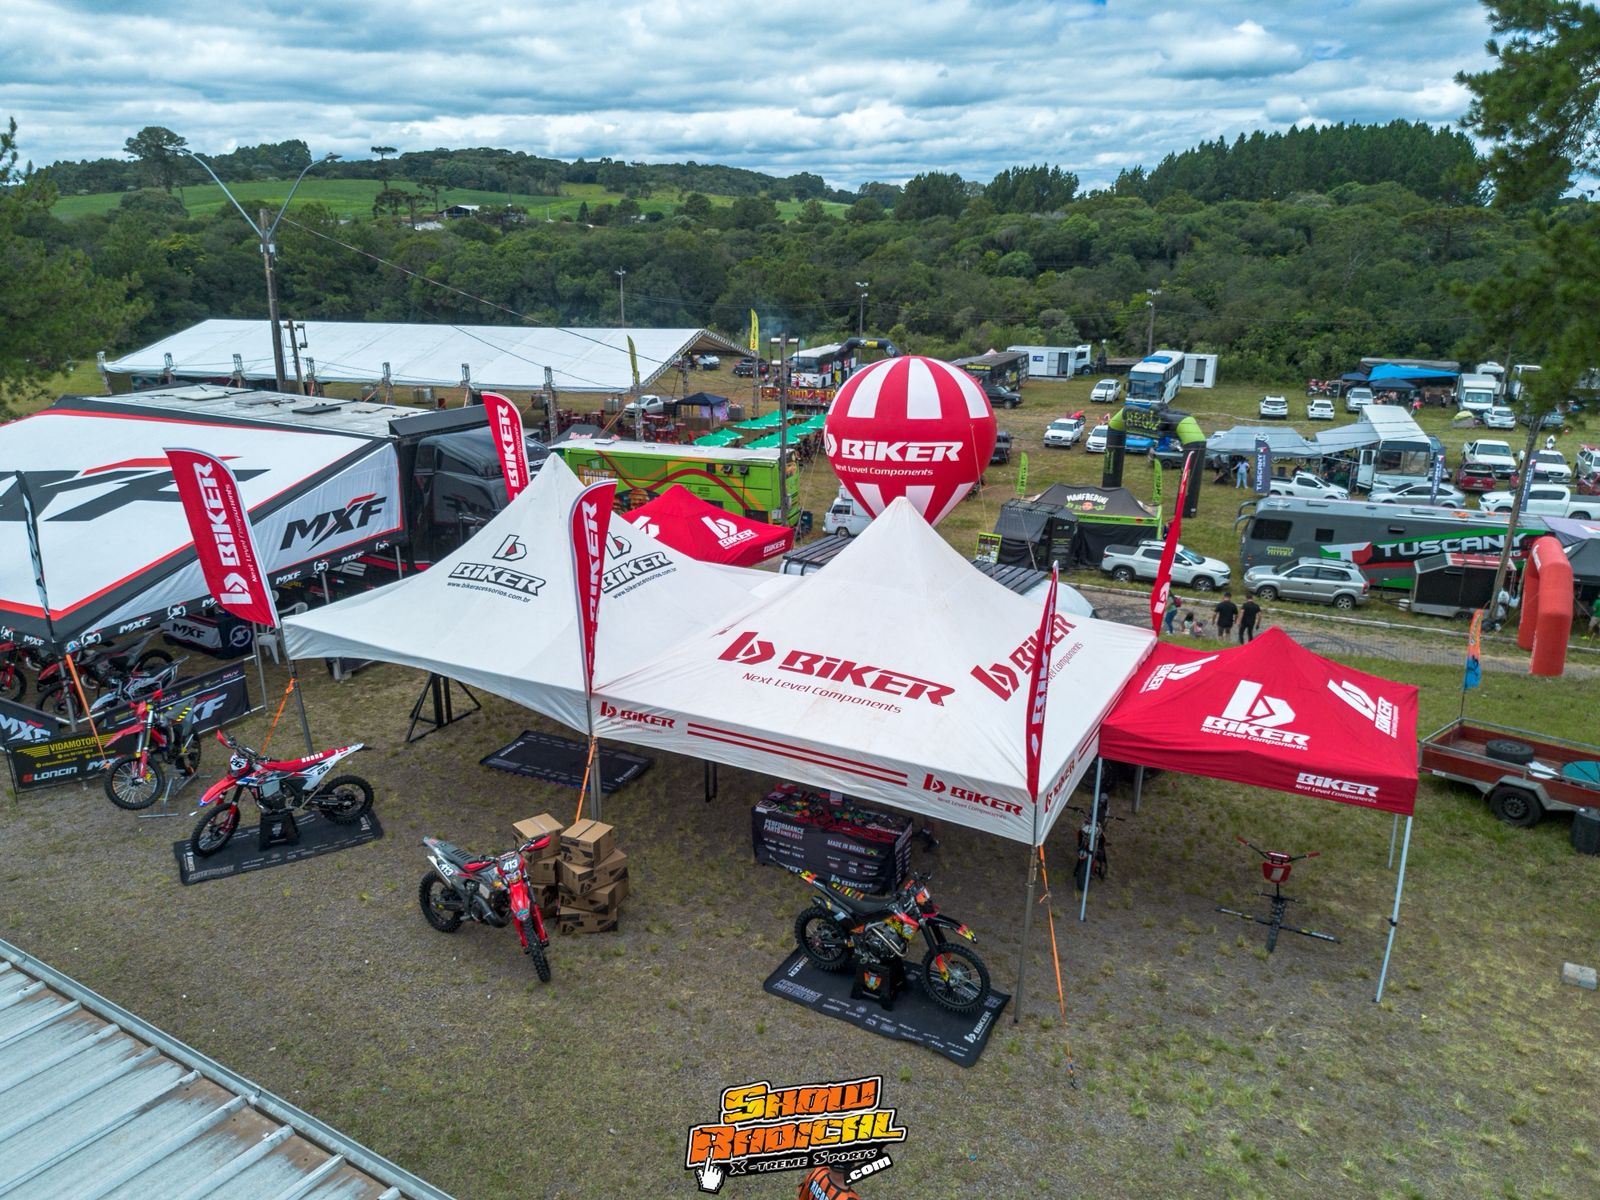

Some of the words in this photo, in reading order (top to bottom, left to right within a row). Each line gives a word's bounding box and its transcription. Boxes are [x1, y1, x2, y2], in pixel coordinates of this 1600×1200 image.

[869, 467, 933, 477] Components
[280, 497, 387, 552] MXF
[276, 571, 302, 584] MXF
[120, 617, 151, 633] MXF
[173, 623, 206, 638] MXF
[24, 635, 45, 646] MXF
[742, 672, 773, 685] Next
[775, 679, 812, 693] Level
[812, 686, 901, 714] Components
[50, 736, 97, 752] VIDAMOTOR
[1200, 726, 1221, 736] Next
[1222, 729, 1247, 741] Level
[1248, 734, 1308, 751] Components
[231, 758, 243, 768] 26
[317, 764, 330, 775] 26
[764, 818, 804, 834] PERFORMANCE
[502, 860, 519, 871] 413
